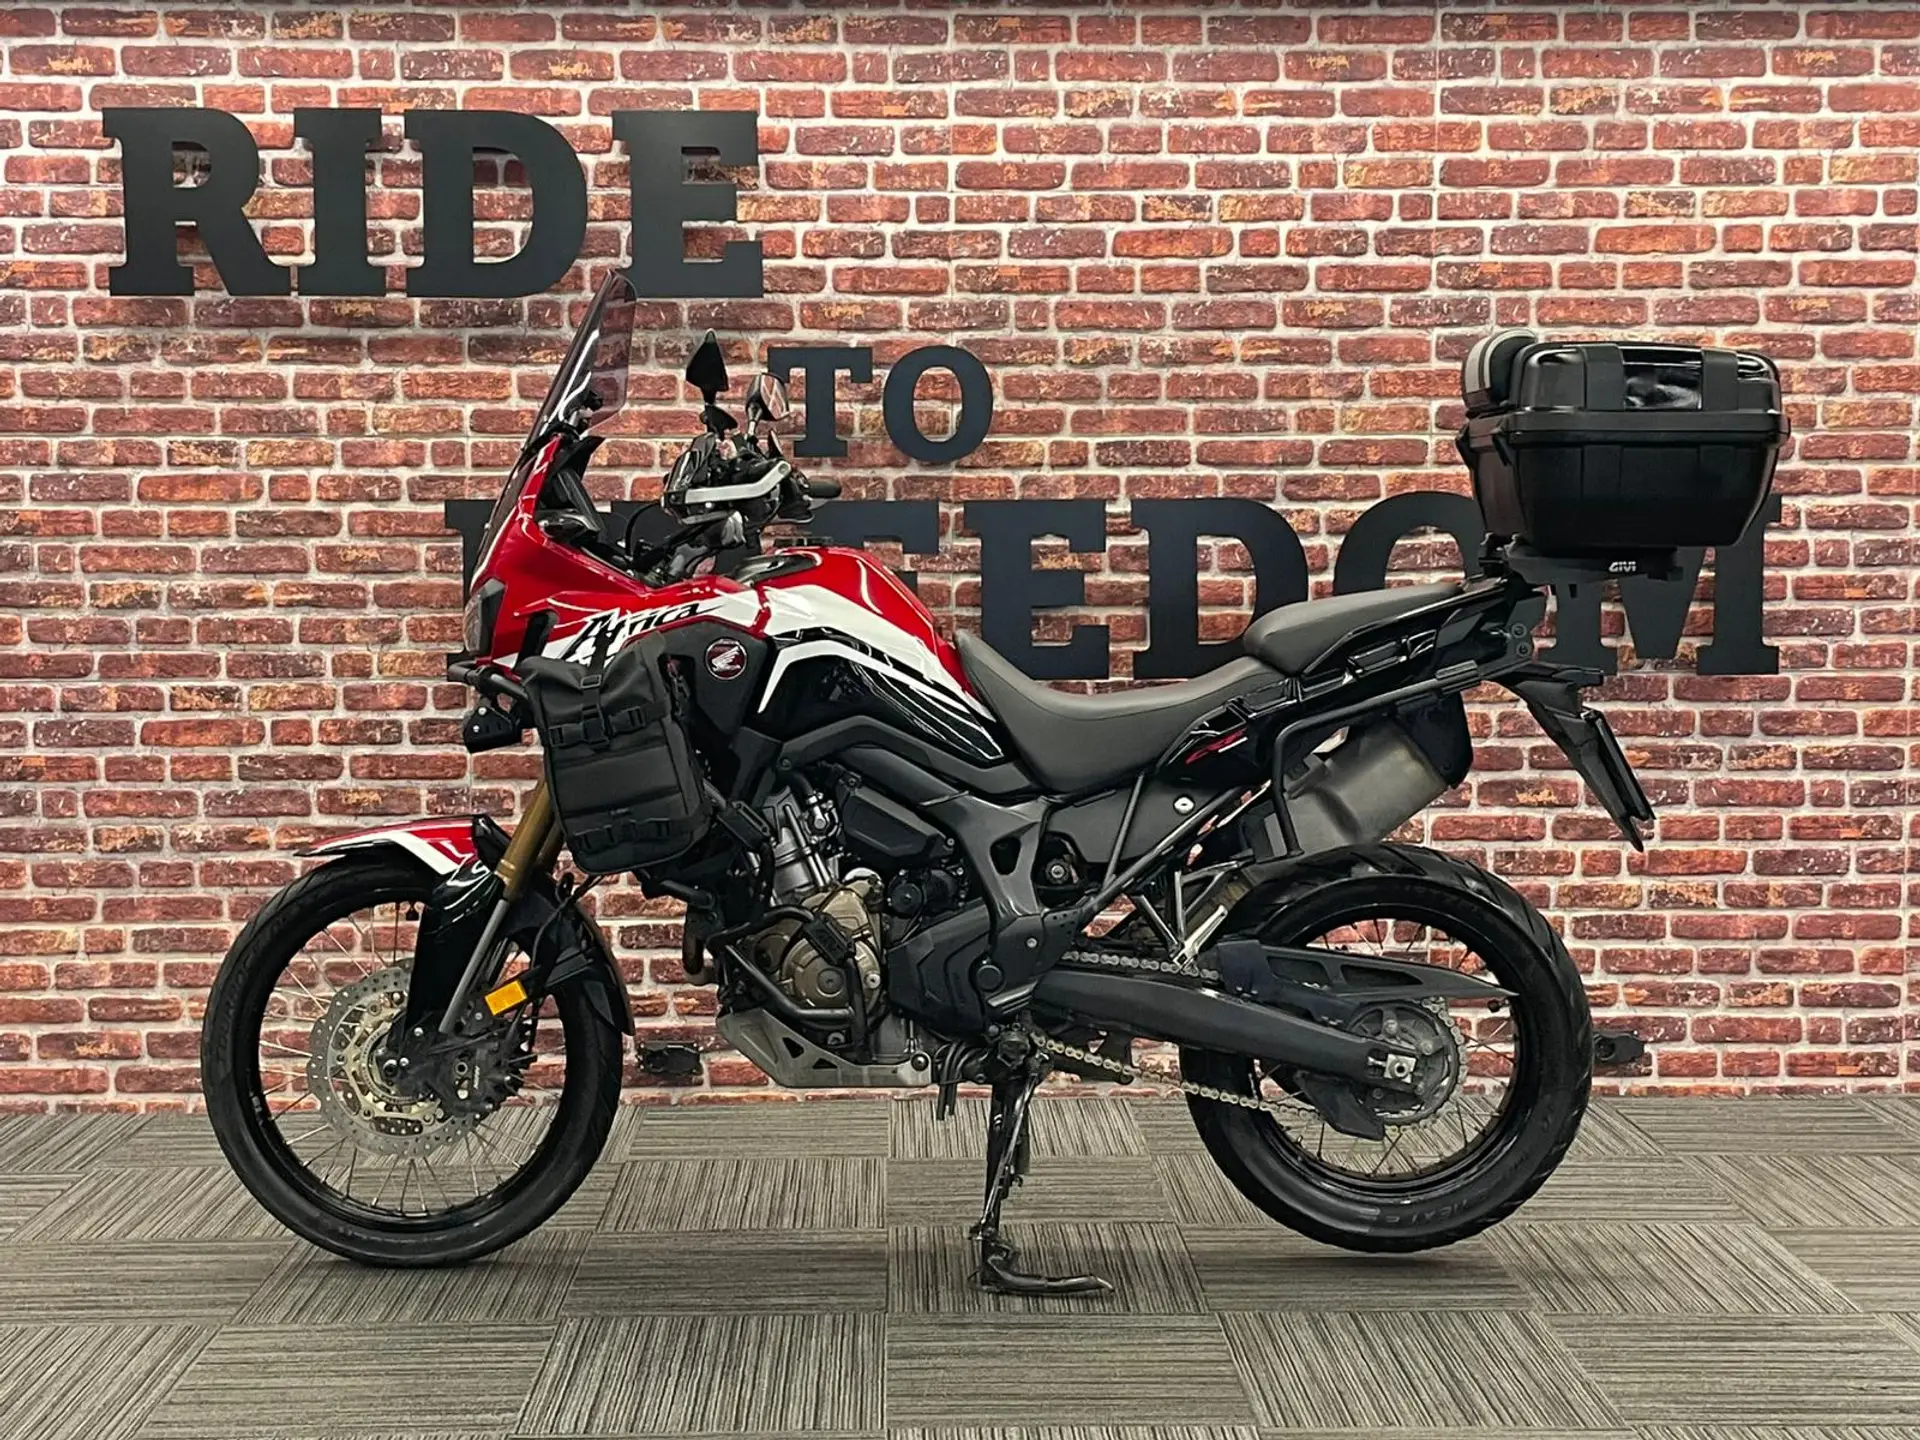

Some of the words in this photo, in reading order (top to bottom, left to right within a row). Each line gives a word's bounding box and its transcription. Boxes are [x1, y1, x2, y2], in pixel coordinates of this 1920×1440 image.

[101, 107, 764, 298] RIDE
[767, 344, 994, 462] TO
[444, 490, 1781, 681] EDOM
[1608, 560, 1637, 573] GIVI
